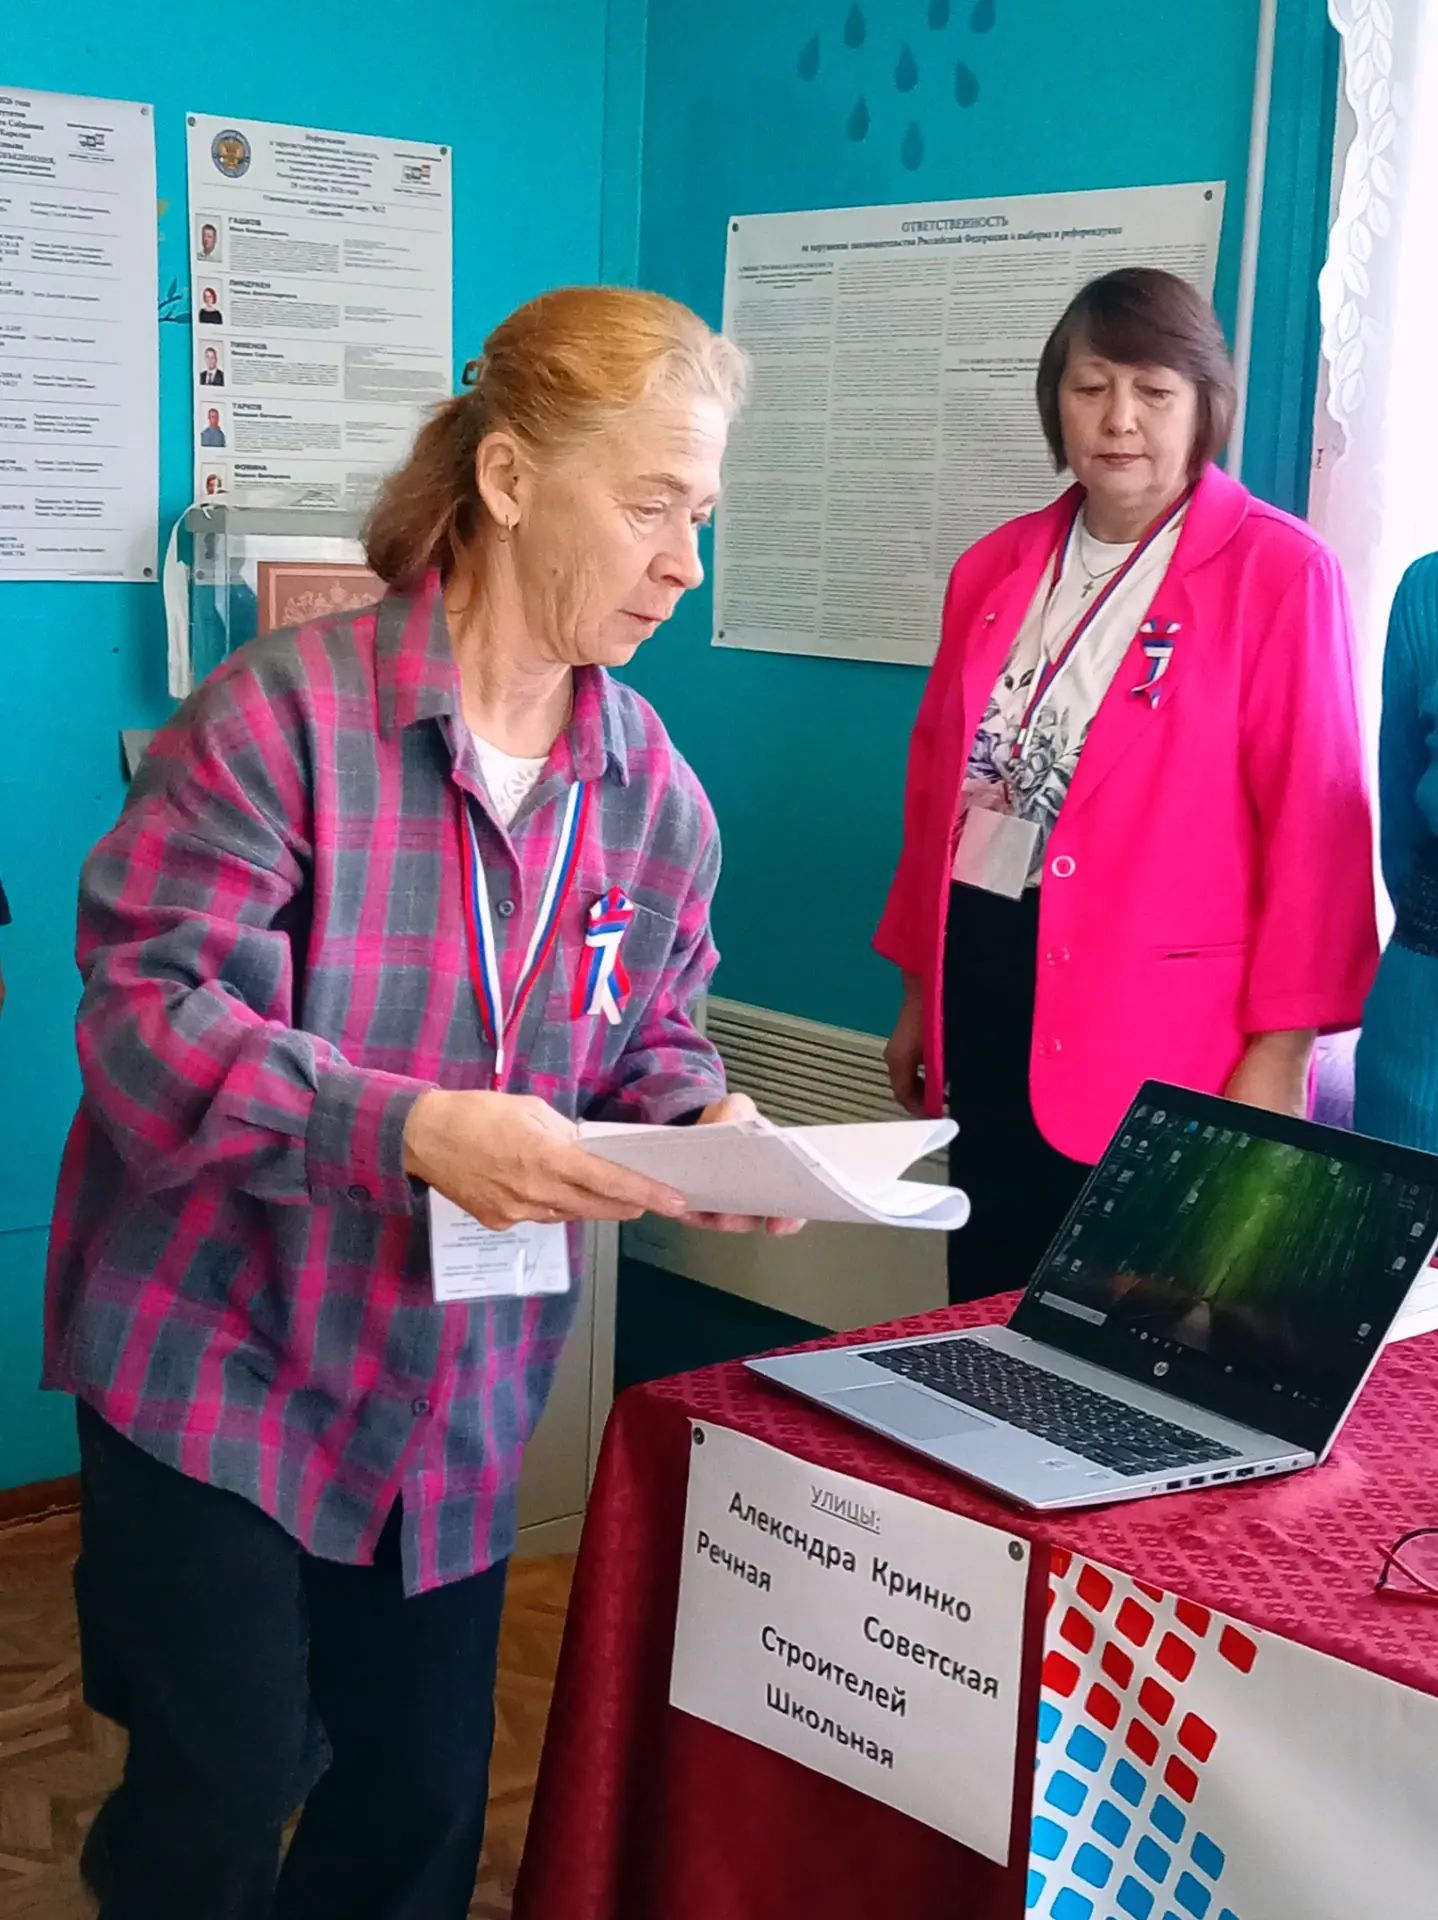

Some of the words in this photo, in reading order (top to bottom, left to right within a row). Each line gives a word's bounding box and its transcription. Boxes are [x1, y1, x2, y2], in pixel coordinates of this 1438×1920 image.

[696, 1530, 772, 1592] Речная
[728, 1491, 856, 1573] Алексндра
[871, 1556, 972, 1623] Кринко
[761, 1625, 907, 1718] Строителей
[863, 1616, 998, 1699] Советская
[766, 1683, 894, 1770] Школьная
